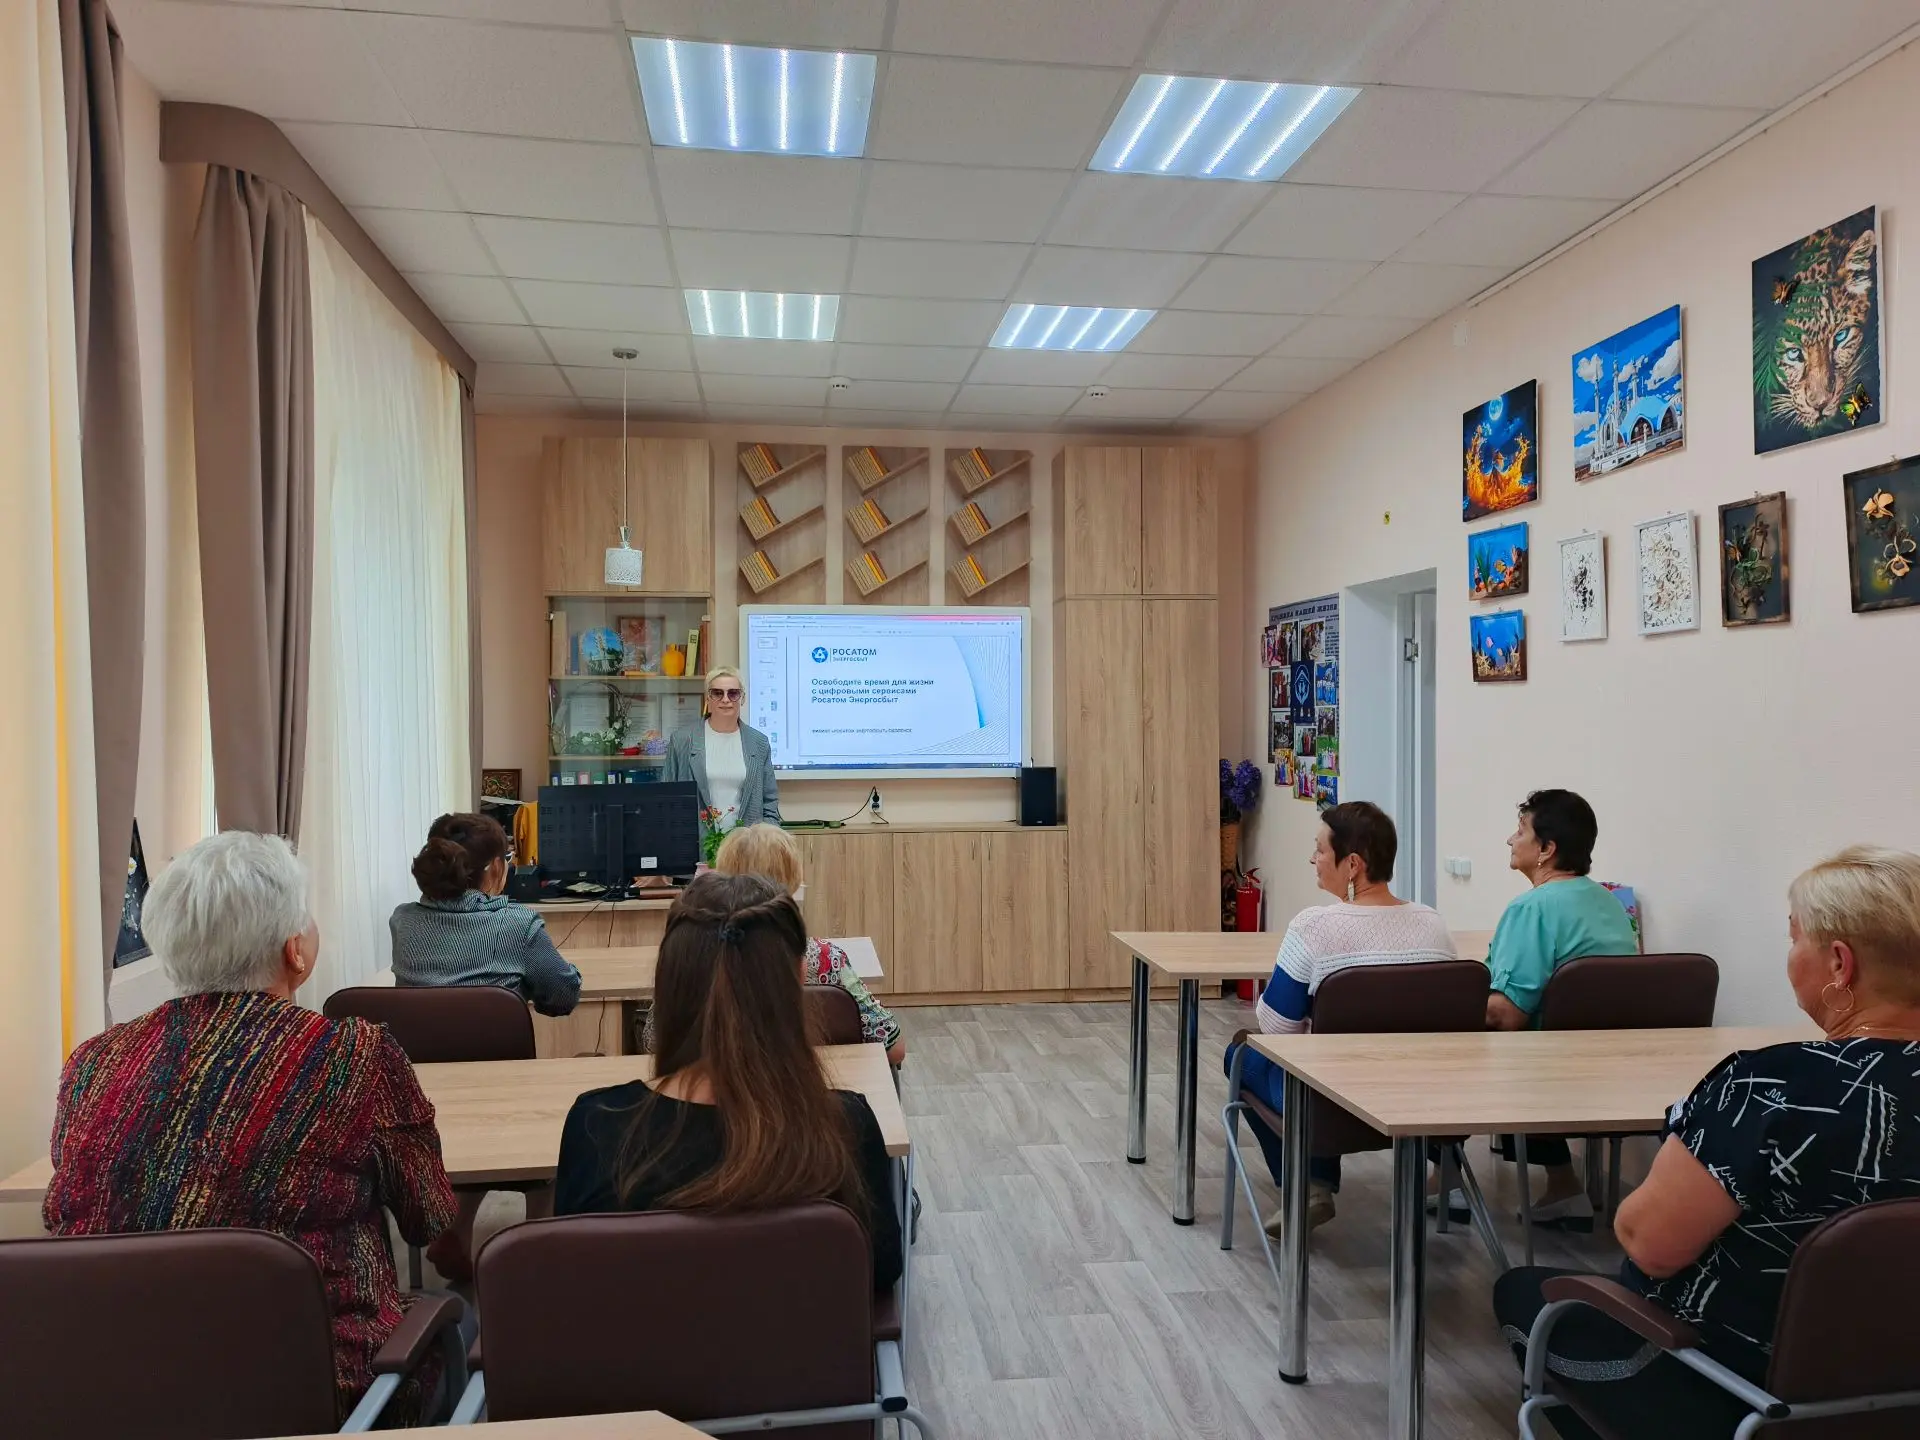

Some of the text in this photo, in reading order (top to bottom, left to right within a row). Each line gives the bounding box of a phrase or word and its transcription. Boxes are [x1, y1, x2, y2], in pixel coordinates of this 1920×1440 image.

[832, 648, 877, 656] РОСАТОМ
[811, 678, 862, 686] Освободите
[819, 687, 870, 696] цифровыми
[811, 695, 899, 704] Росатом Энергосбыт
